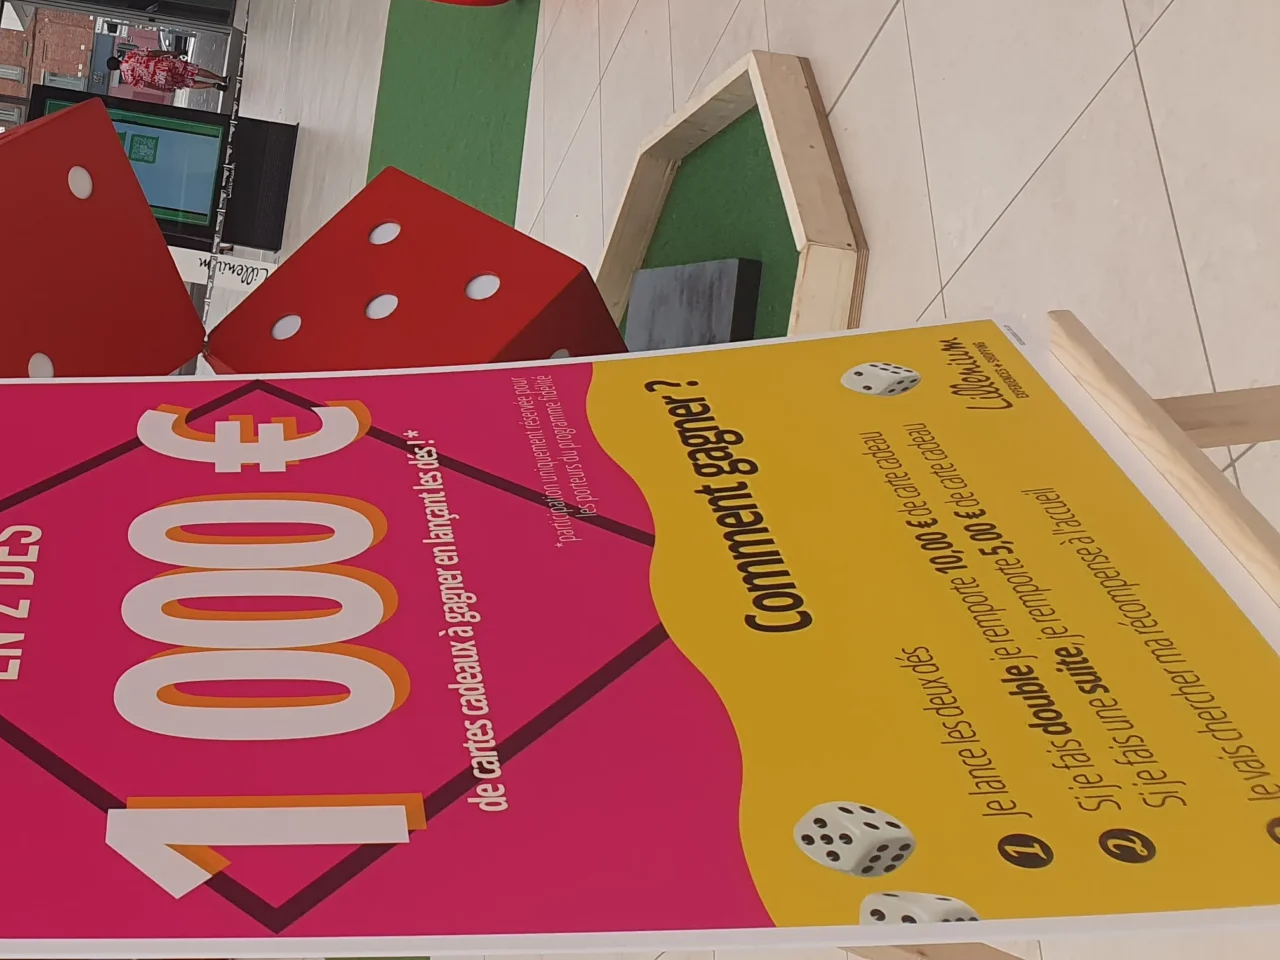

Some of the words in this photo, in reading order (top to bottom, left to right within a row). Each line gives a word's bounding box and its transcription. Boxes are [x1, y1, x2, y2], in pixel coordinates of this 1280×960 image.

[510, 377, 538, 394] pour
[531, 375, 561, 401] fidélité
[644, 380, 699, 393] ?
[938, 337, 1014, 410] Lillenium
[514, 396, 540, 428] réservée
[546, 402, 582, 448] programme
[136, 400, 372, 473] €
[661, 395, 759, 478] gagner
[859, 431, 902, 470] cadeau
[903, 422, 948, 460] cadeau
[407, 446, 440, 469] dés
[527, 430, 559, 482] uniquement
[558, 448, 580, 462] du
[412, 471, 444, 490] les
[566, 464, 600, 501] porteurs
[884, 471, 921, 498] carte
[930, 462, 968, 490] carte
[574, 504, 598, 517] les
[896, 500, 932, 516] de
[944, 491, 980, 508] de
[953, 508, 986, 520] €
[1020, 488, 1087, 535] l'accueil
[418, 492, 460, 543] lançant
[905, 518, 939, 528] €
[914, 532, 968, 574] 10,00
[963, 522, 1014, 556] 5,00
[1060, 536, 1096, 545] à
[432, 546, 459, 565] en
[694, 481, 813, 633] Comment
[436, 568, 481, 622] gagner
[994, 558, 1062, 623] remporte
[1076, 546, 1164, 634] récompense
[113, 492, 411, 741] 000
[950, 576, 1015, 644] remporte
[438, 626, 474, 637] à
[1036, 626, 1086, 640] je
[894, 646, 940, 674] dés
[990, 646, 1038, 661] je
[1144, 638, 1187, 664] ma
[448, 640, 490, 715] cadeaux
[1054, 642, 1110, 694] suite,
[918, 676, 964, 717] deux
[1000, 664, 1072, 736] double
[1163, 668, 1244, 742] chercher
[1088, 697, 1134, 732] une
[940, 720, 980, 744] les
[462, 719, 502, 779] cartes
[1046, 738, 1096, 770] fais
[1108, 734, 1159, 766] fais
[1218, 744, 1271, 780] vais
[958, 748, 1010, 796] lance
[1068, 774, 1122, 790] je
[1132, 769, 1186, 786] je
[467, 784, 508, 812] de
[982, 799, 1032, 818] Je
[1074, 794, 1122, 812] Si
[1138, 790, 1187, 808] Si
[105, 793, 427, 899] 1
